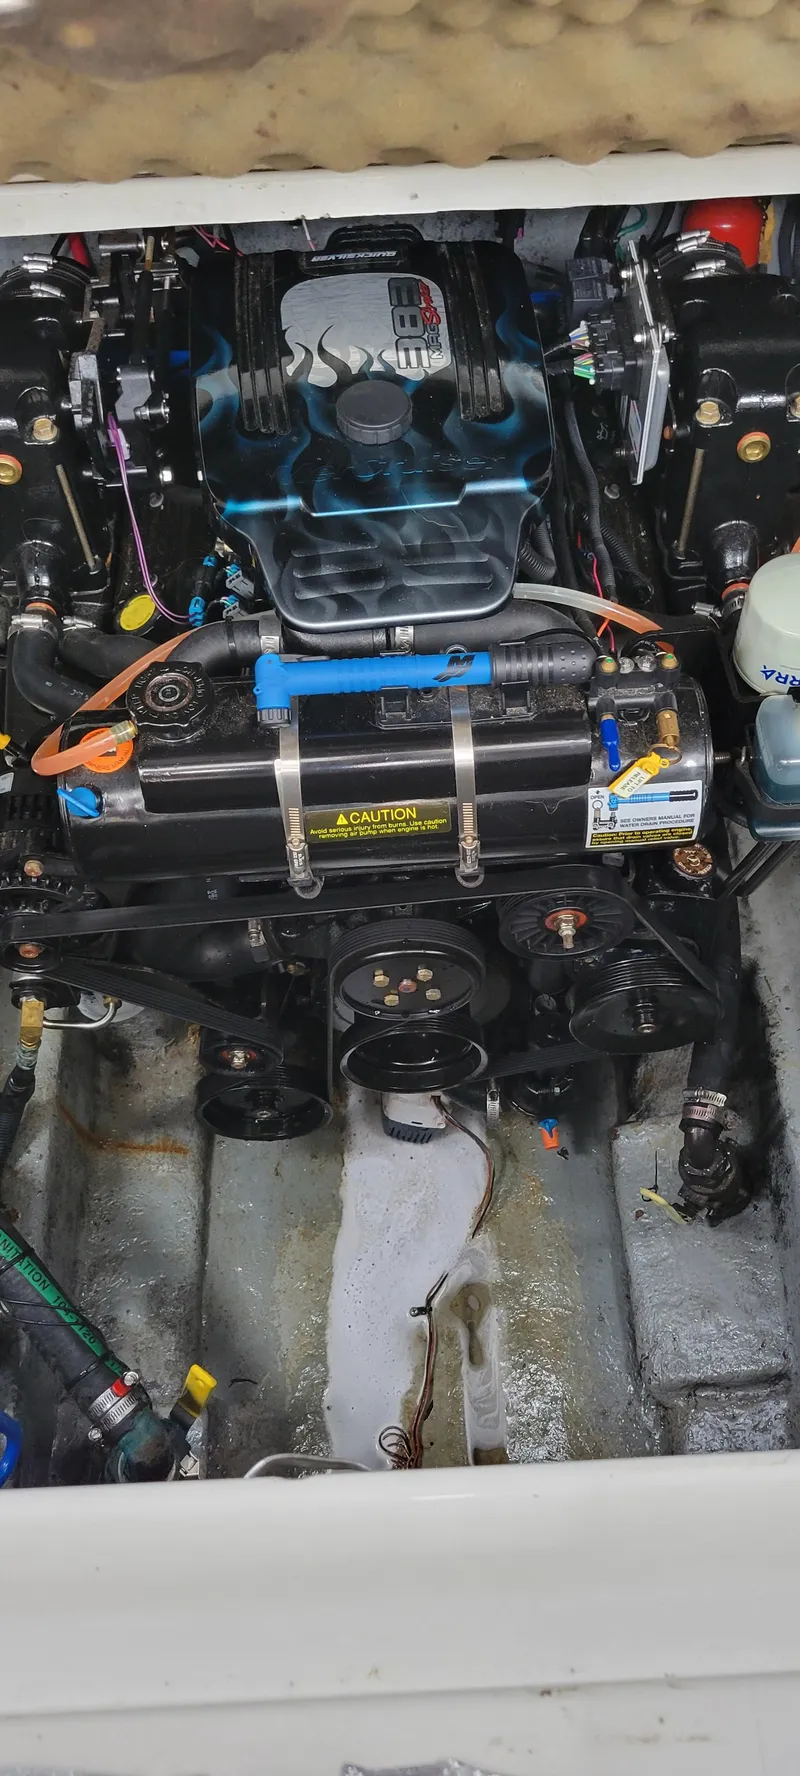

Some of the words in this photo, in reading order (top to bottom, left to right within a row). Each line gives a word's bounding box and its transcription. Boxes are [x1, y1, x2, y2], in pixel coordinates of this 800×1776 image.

[311, 250, 398, 262] QUICKSILVER
[388, 276, 430, 369] 383
[426, 323, 444, 359] MAG
[350, 807, 416, 824] CAUTION
[0, 1232, 51, 1292] NITATION
